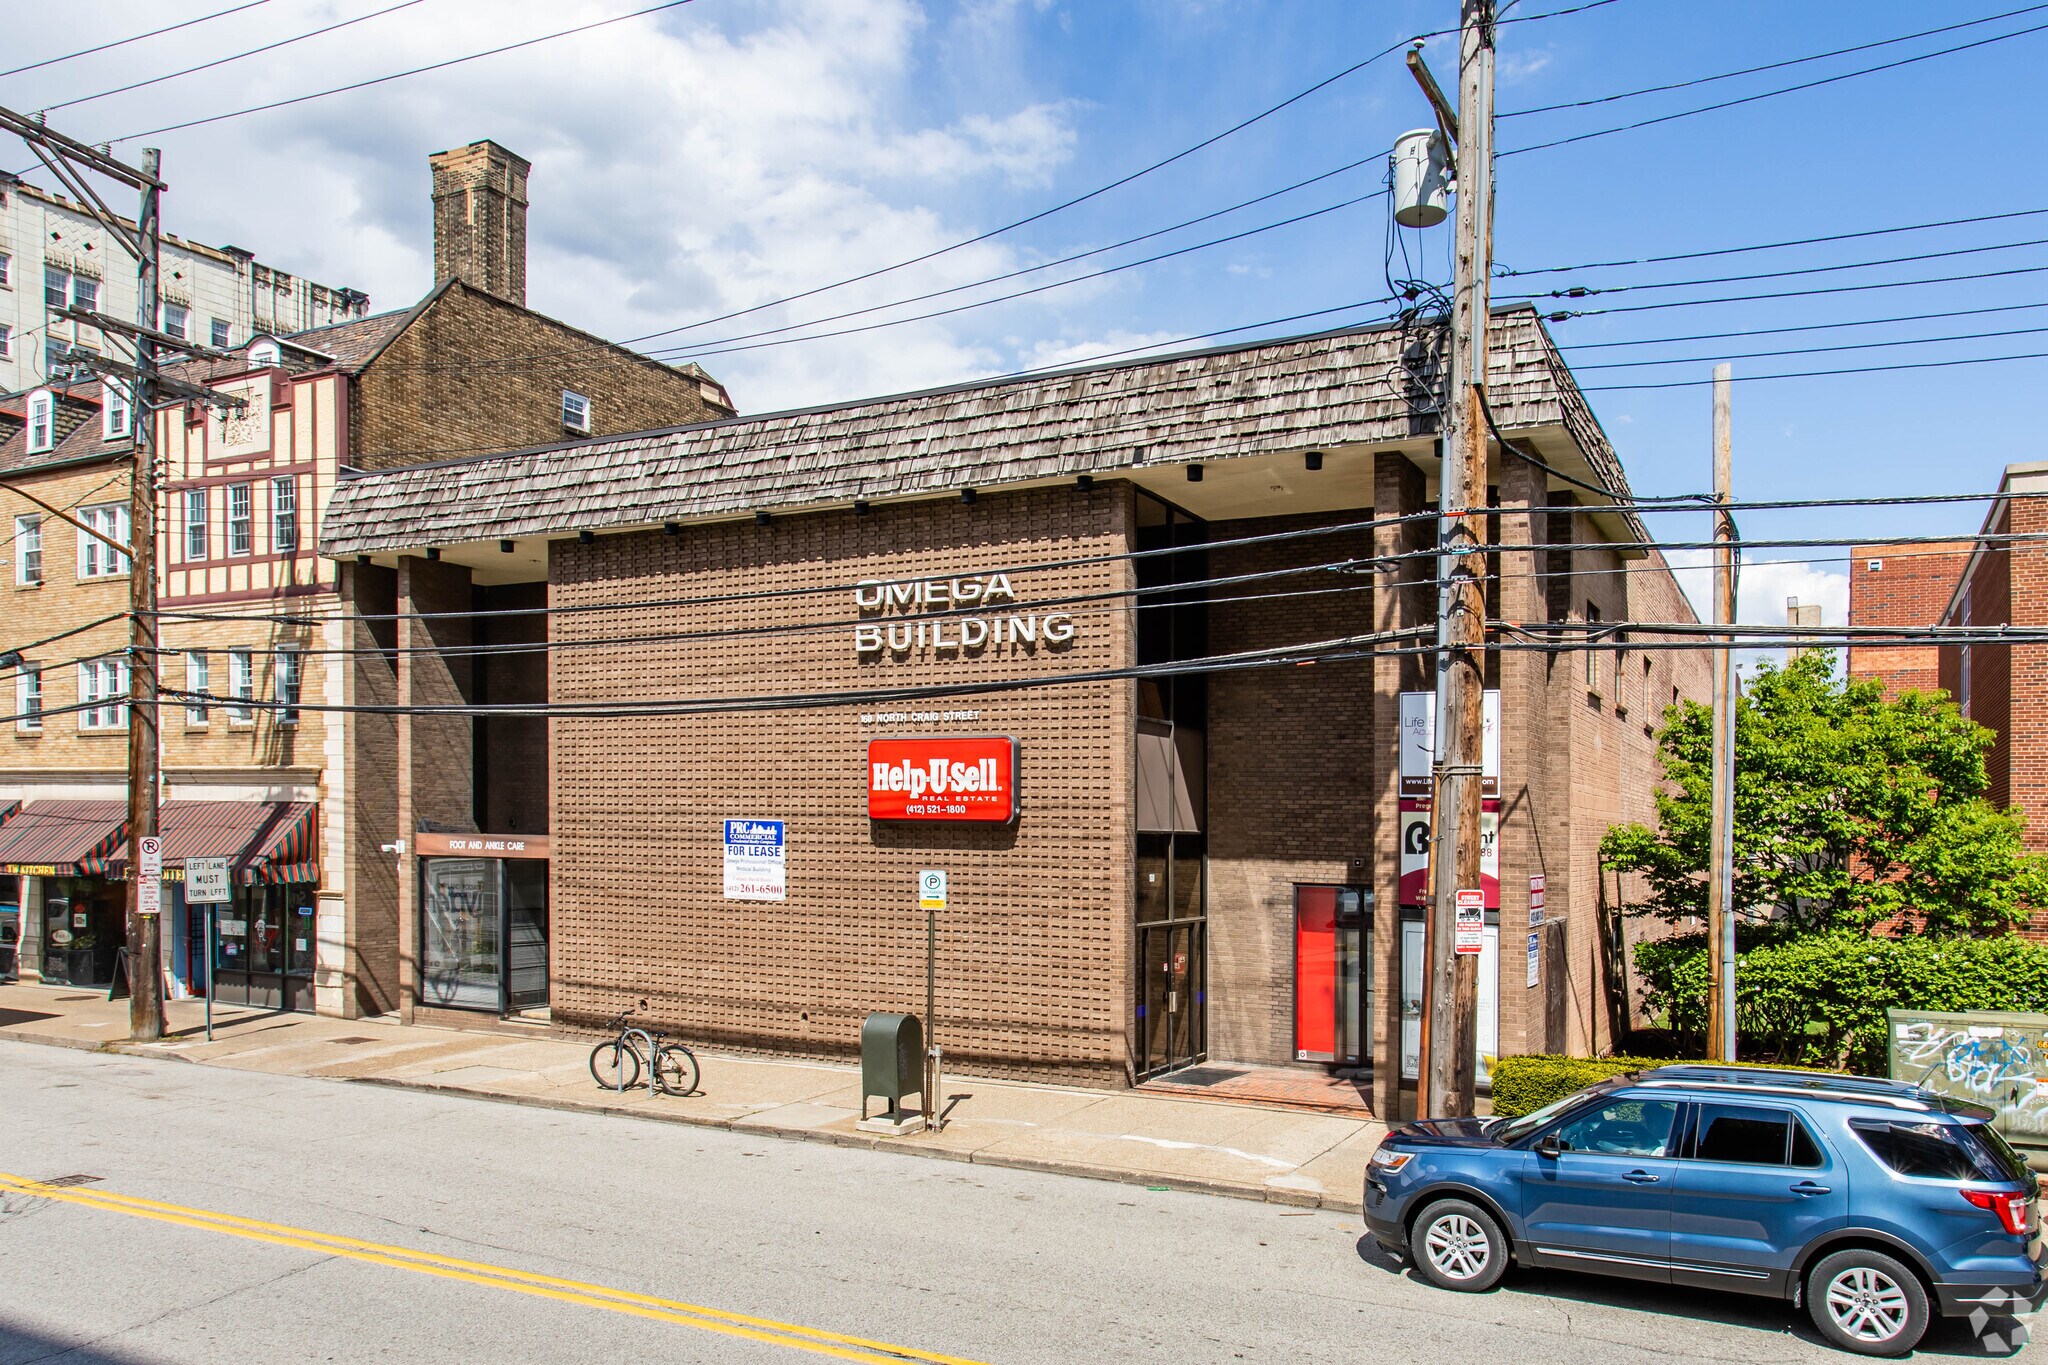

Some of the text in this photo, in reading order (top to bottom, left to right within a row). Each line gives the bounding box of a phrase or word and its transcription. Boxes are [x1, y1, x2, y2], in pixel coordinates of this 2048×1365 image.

[855, 573, 1016, 606] OMEGA
[855, 613, 1075, 652] BUILDING
[876, 712, 907, 723] NORTH
[911, 711, 939, 722] CRAIG
[943, 710, 980, 722] STREET
[1404, 716, 1425, 728] Life
[906, 804, 966, 816] (412) 521-1800
[730, 822, 750, 834] PRC
[449, 840, 525, 851] FOOT AND ANKLE CARE
[728, 845, 781, 857] FOR LEASE
[20, 864, 55, 875] KITCHEN
[208, 862, 225, 870] LANE
[196, 874, 219, 884] MUST
[189, 888, 226, 897] TURN LEFT
[740, 883, 782, 894] 261-6500
